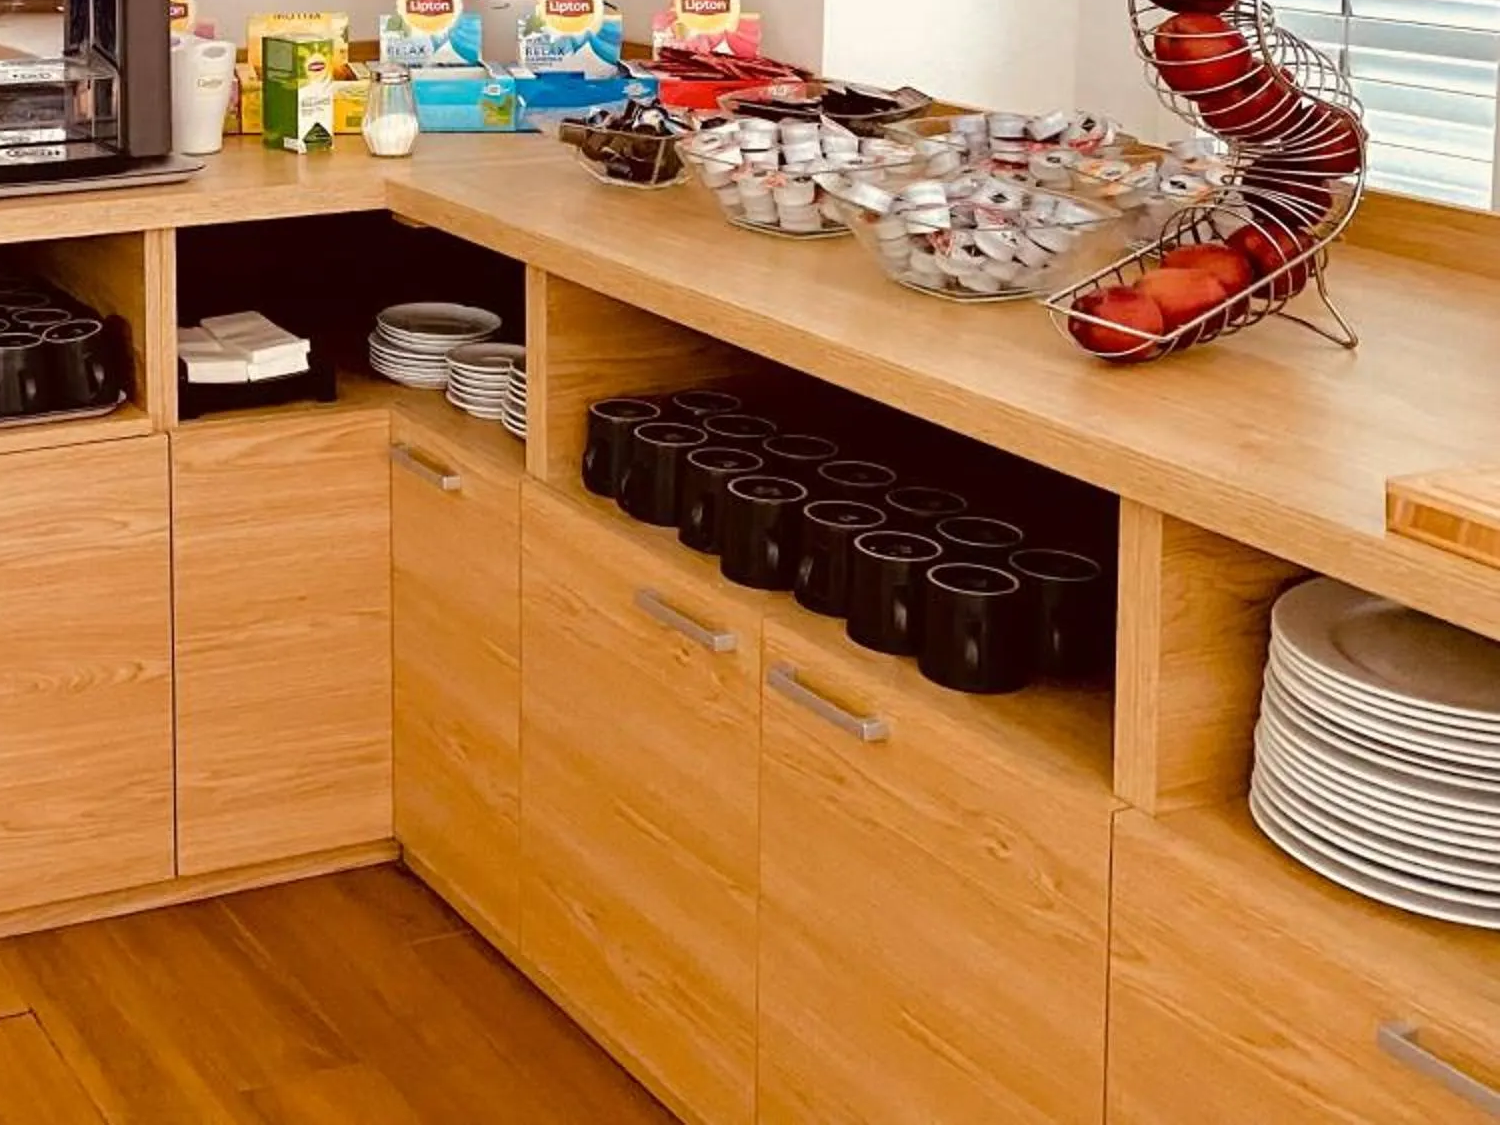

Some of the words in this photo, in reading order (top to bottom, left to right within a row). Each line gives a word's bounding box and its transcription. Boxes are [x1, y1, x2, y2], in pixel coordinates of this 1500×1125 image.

[411, 0, 450, 13] Lipton
[549, 0, 590, 13] Lipton
[525, 46, 565, 56] RELAX
